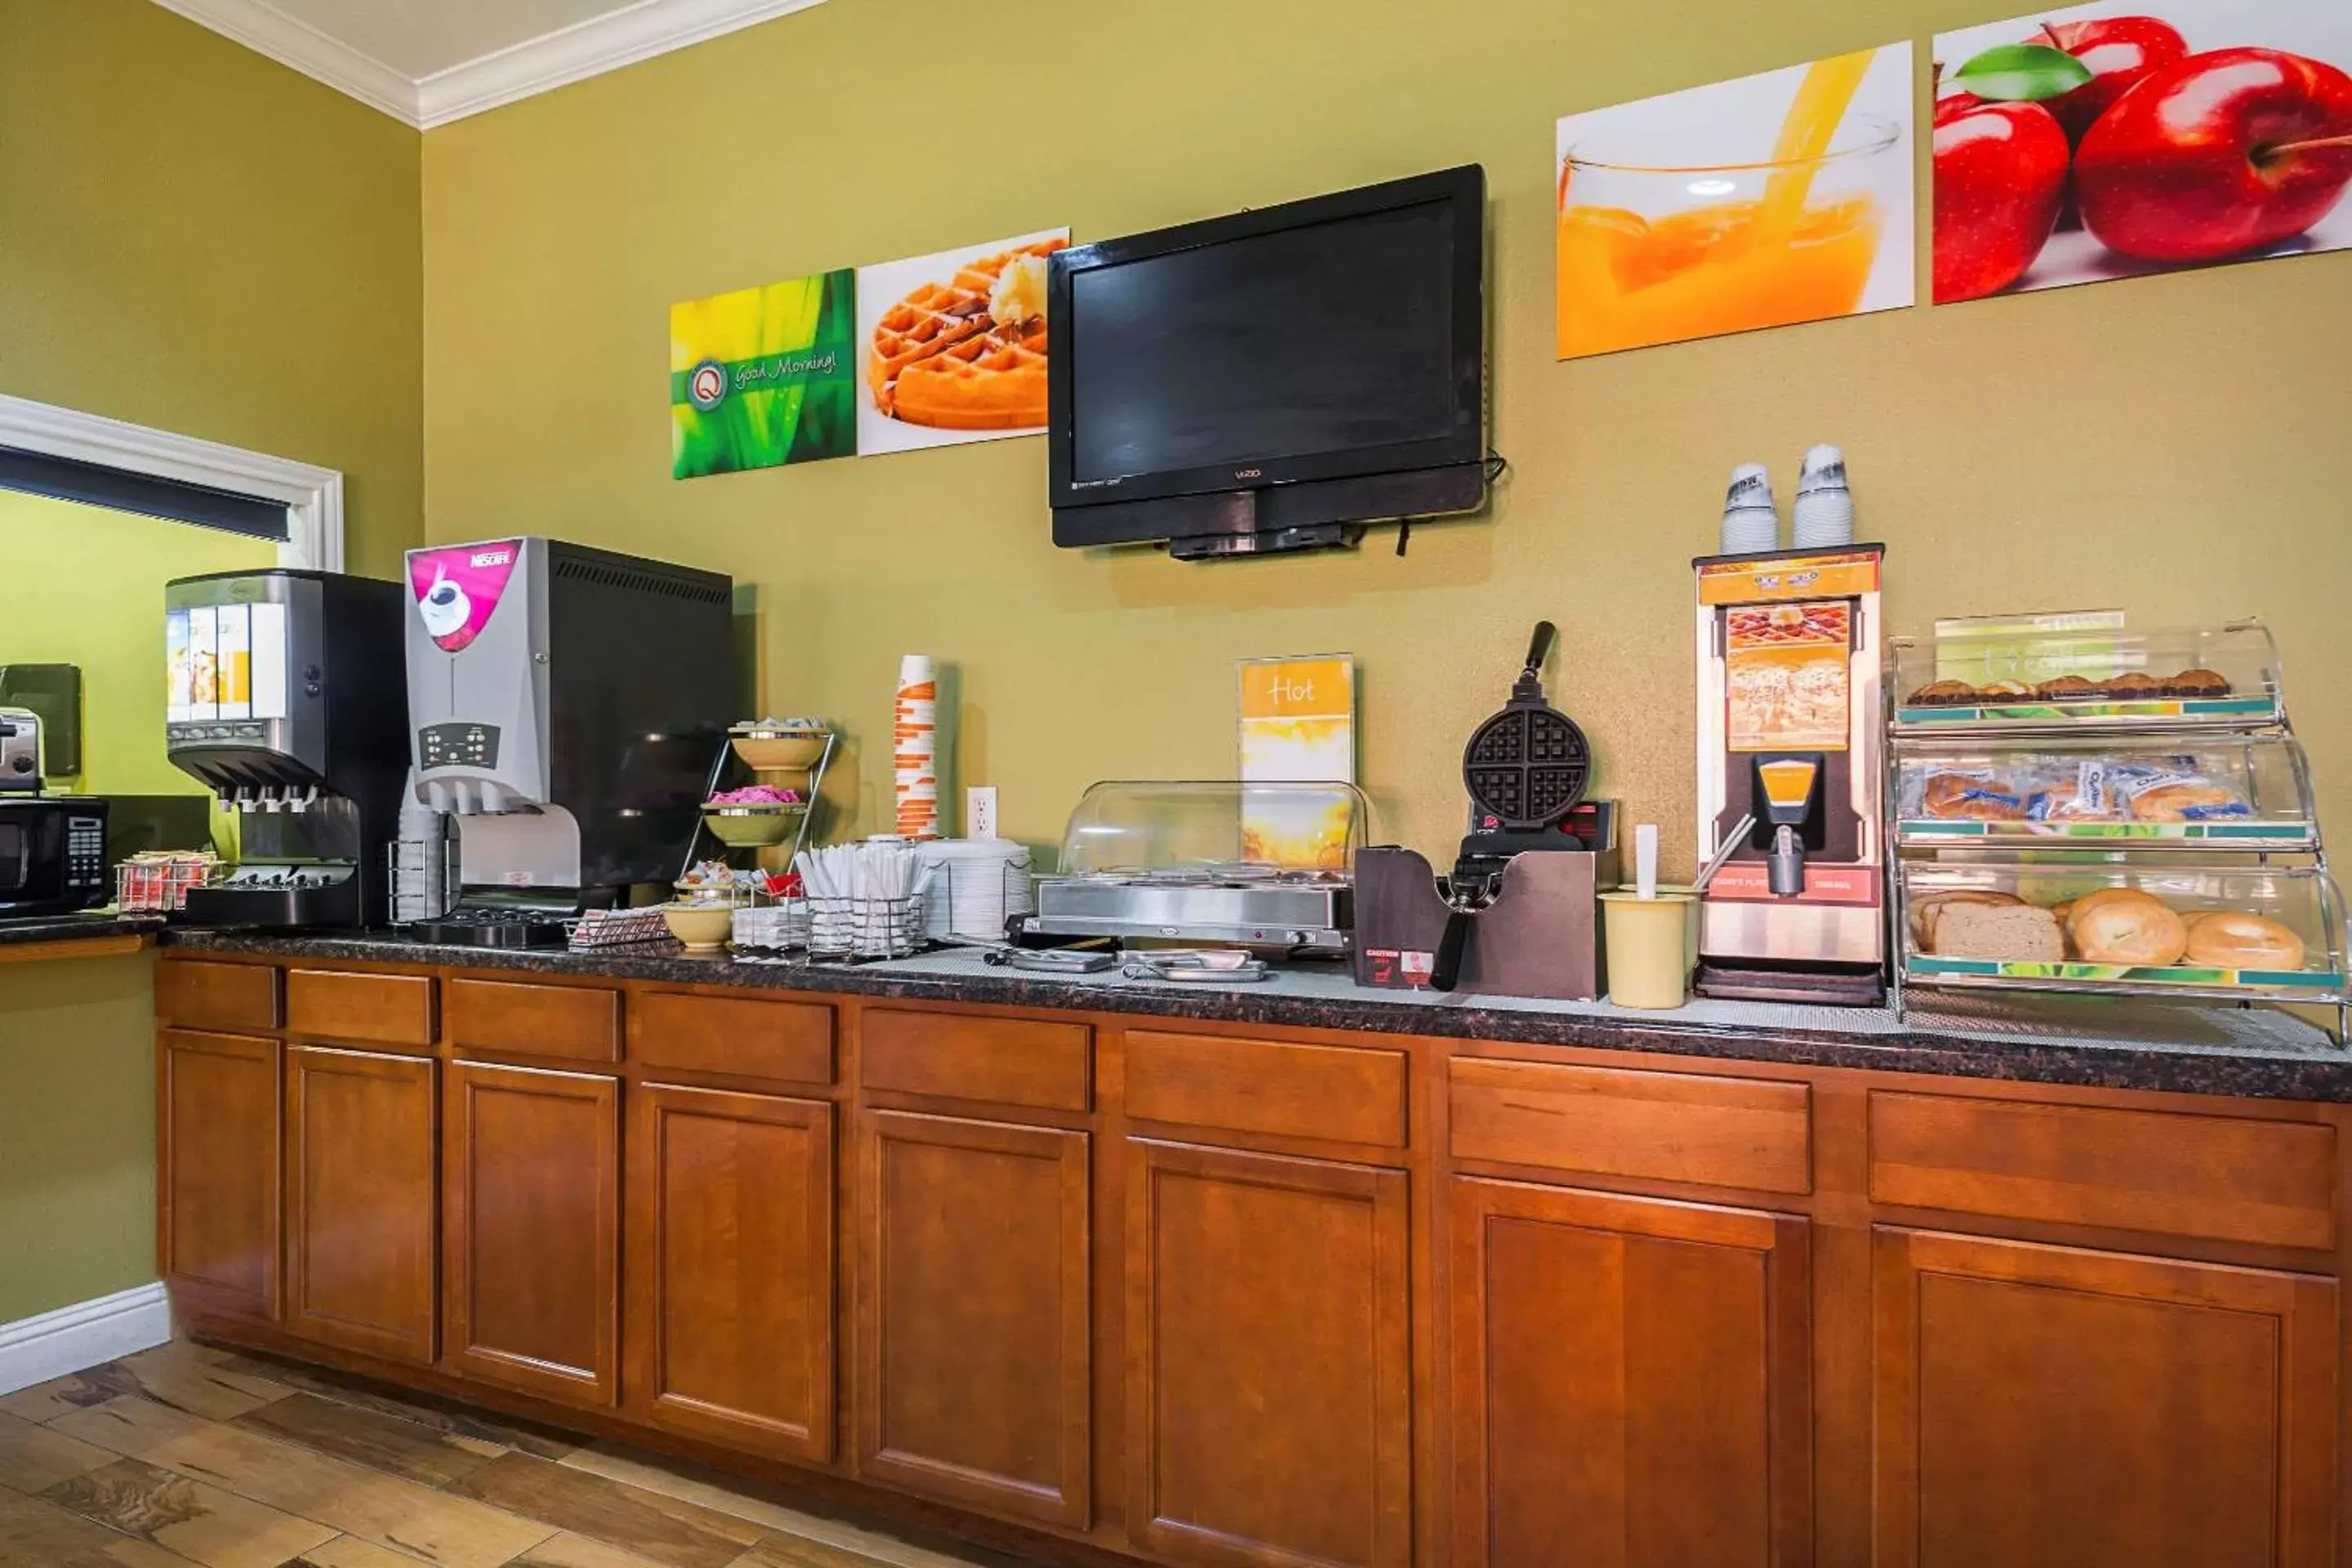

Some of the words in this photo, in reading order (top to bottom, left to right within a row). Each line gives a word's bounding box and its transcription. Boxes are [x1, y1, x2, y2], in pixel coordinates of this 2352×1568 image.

[735, 362, 766, 390] Good
[768, 350, 836, 379] Morning!
[1267, 675, 1316, 705] Hot
